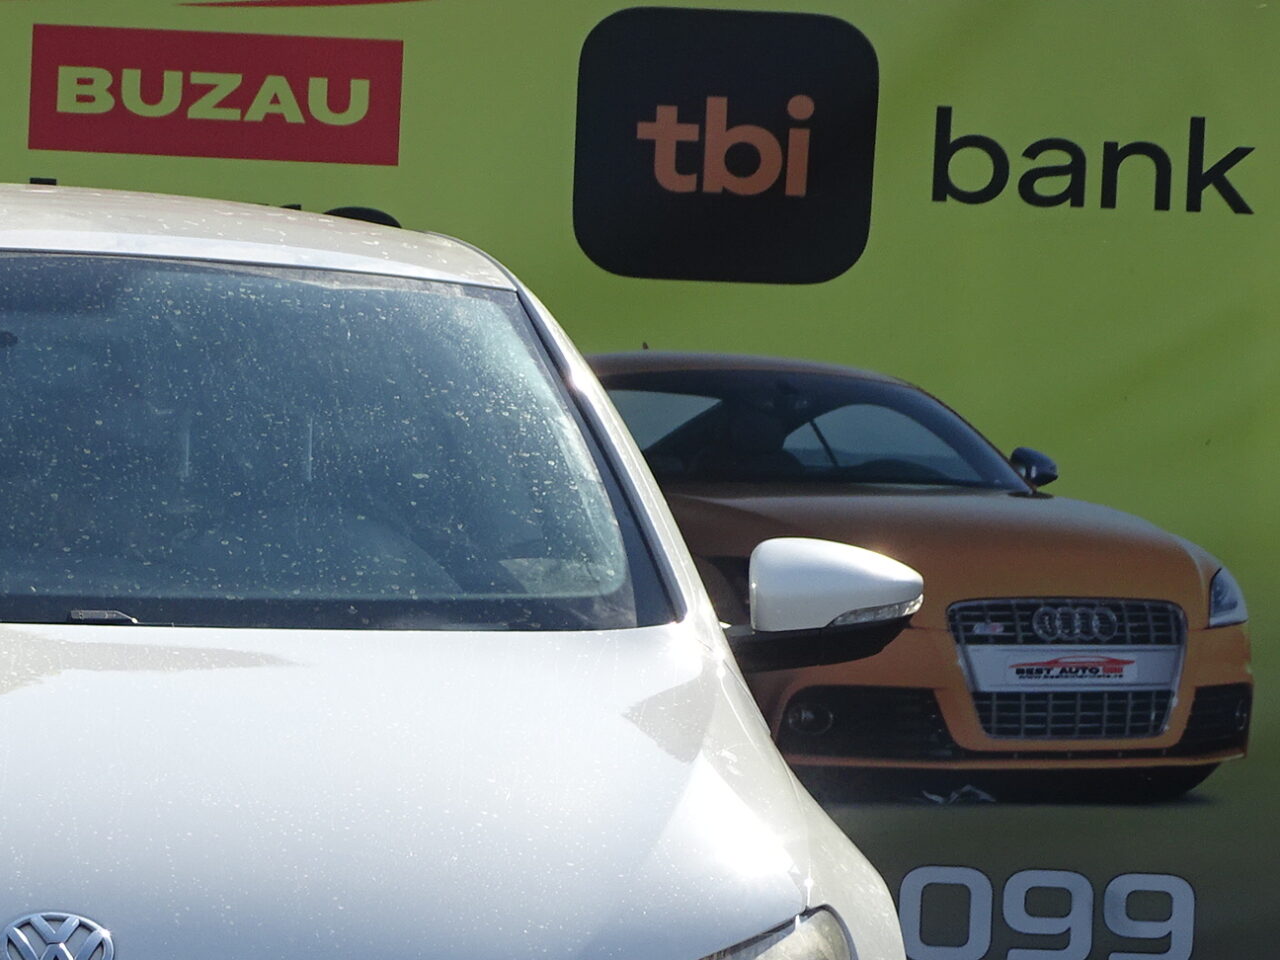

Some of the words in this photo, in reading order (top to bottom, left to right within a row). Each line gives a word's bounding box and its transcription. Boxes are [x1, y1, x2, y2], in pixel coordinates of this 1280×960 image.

[57, 65, 371, 126] BUZAU
[636, 94, 815, 197] tbi
[931, 105, 1256, 215] bank
